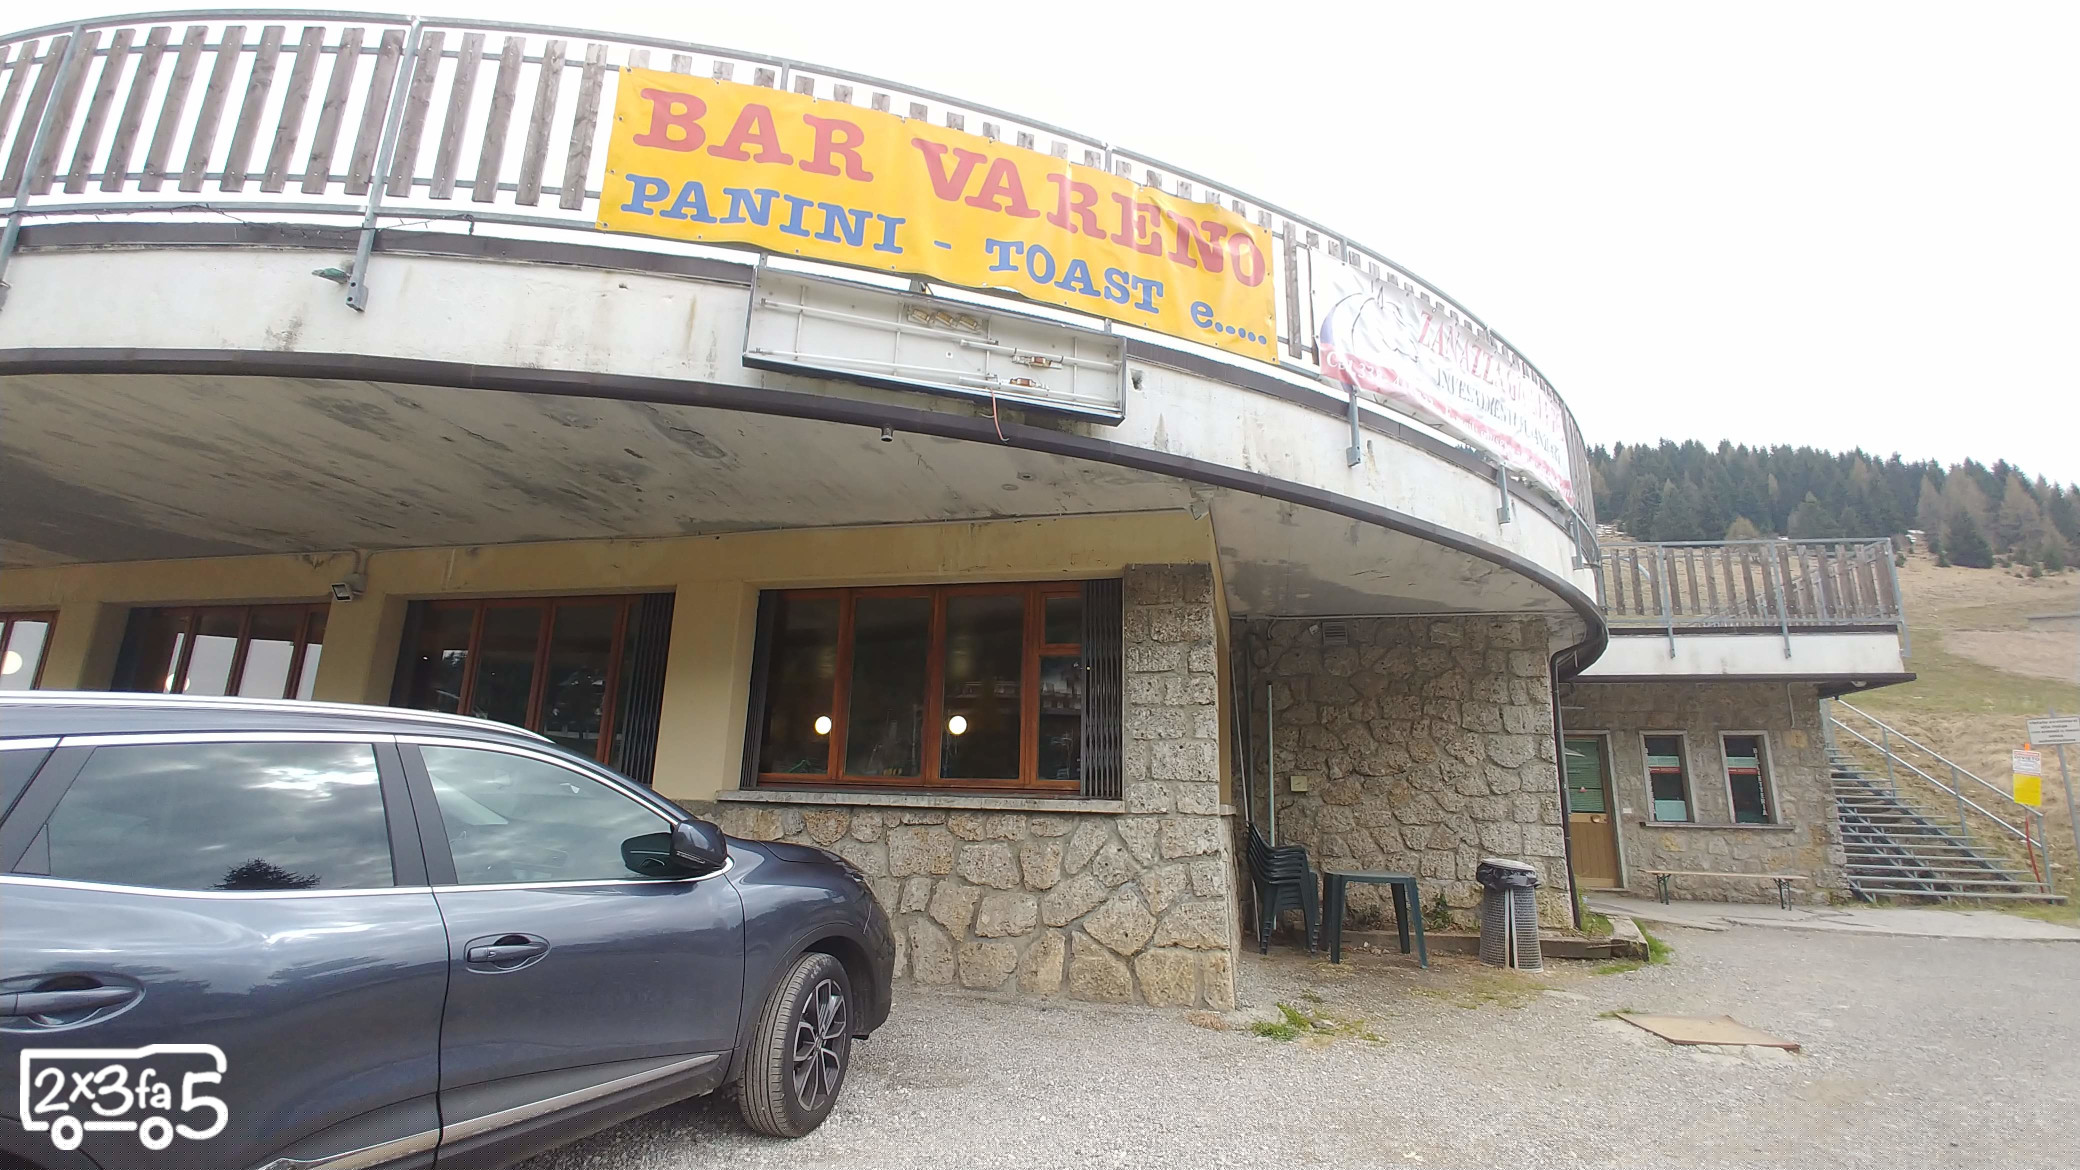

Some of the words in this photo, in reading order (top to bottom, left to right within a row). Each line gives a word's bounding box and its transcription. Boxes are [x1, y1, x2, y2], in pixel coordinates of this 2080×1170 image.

[620, 173, 906, 254] PANINI
[985, 238, 1164, 314] TOAST
[632, 87, 874, 183] BAR
[911, 137, 1266, 287] VARENO
